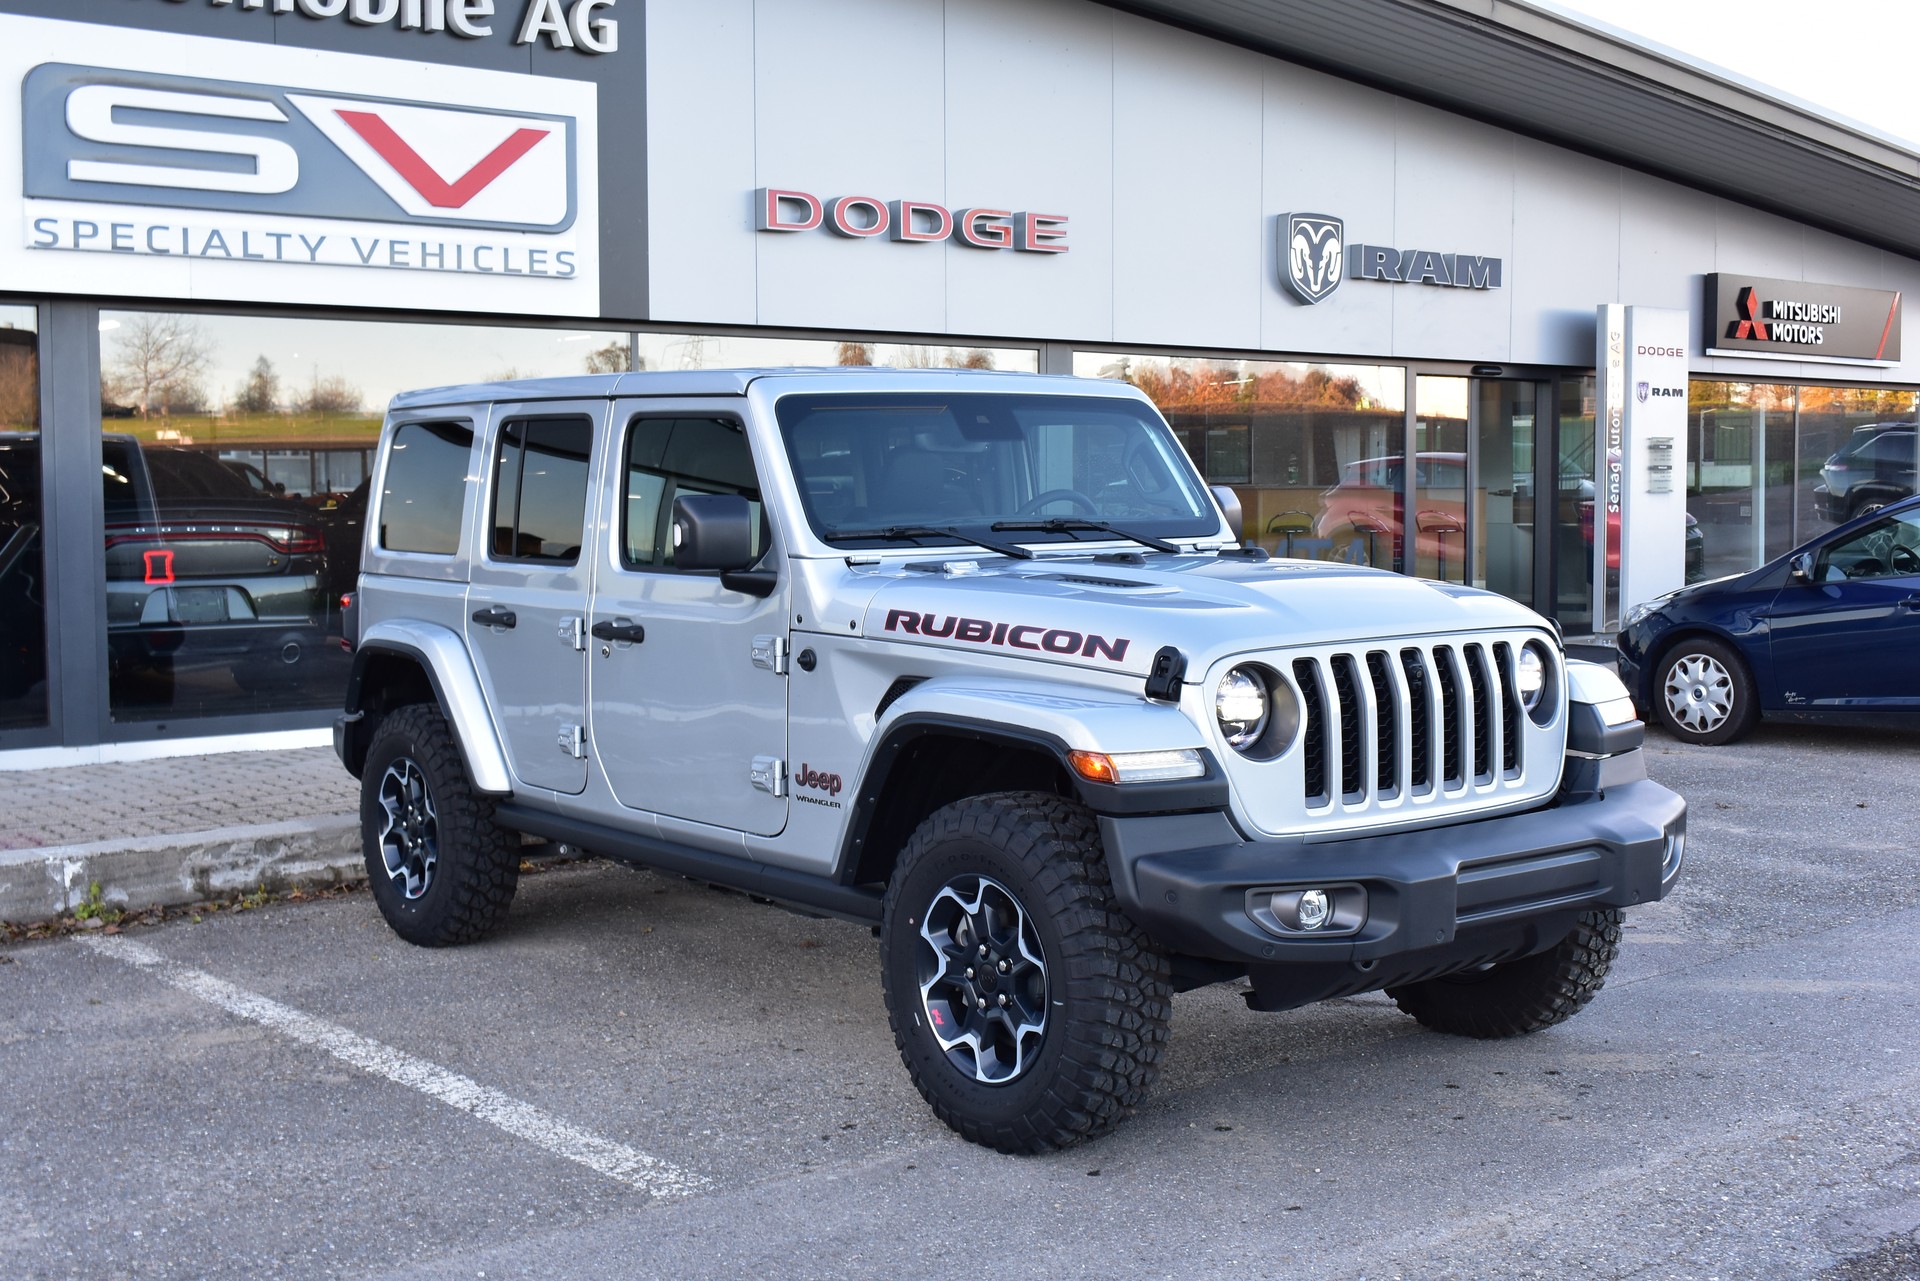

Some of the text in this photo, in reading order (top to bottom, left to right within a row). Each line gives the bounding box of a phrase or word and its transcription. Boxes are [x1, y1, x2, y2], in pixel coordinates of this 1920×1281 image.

[516, 0, 619, 54] AG
[66, 84, 552, 209] SV
[757, 187, 1070, 254] DODGE
[33, 217, 576, 277] SPECIALTY VEHICLES
[1351, 243, 1502, 290] RAM
[1772, 300, 1841, 324] MITSUBISHI
[1772, 322, 1824, 345] MOTORS
[1637, 345, 1684, 358] DODGE
[1651, 387, 1684, 398] RAM
[1608, 462, 1622, 513] Senag
[884, 608, 1131, 663] RUBICON
[795, 762, 842, 797] Jeep
[795, 794, 841, 809] WRANGLER
